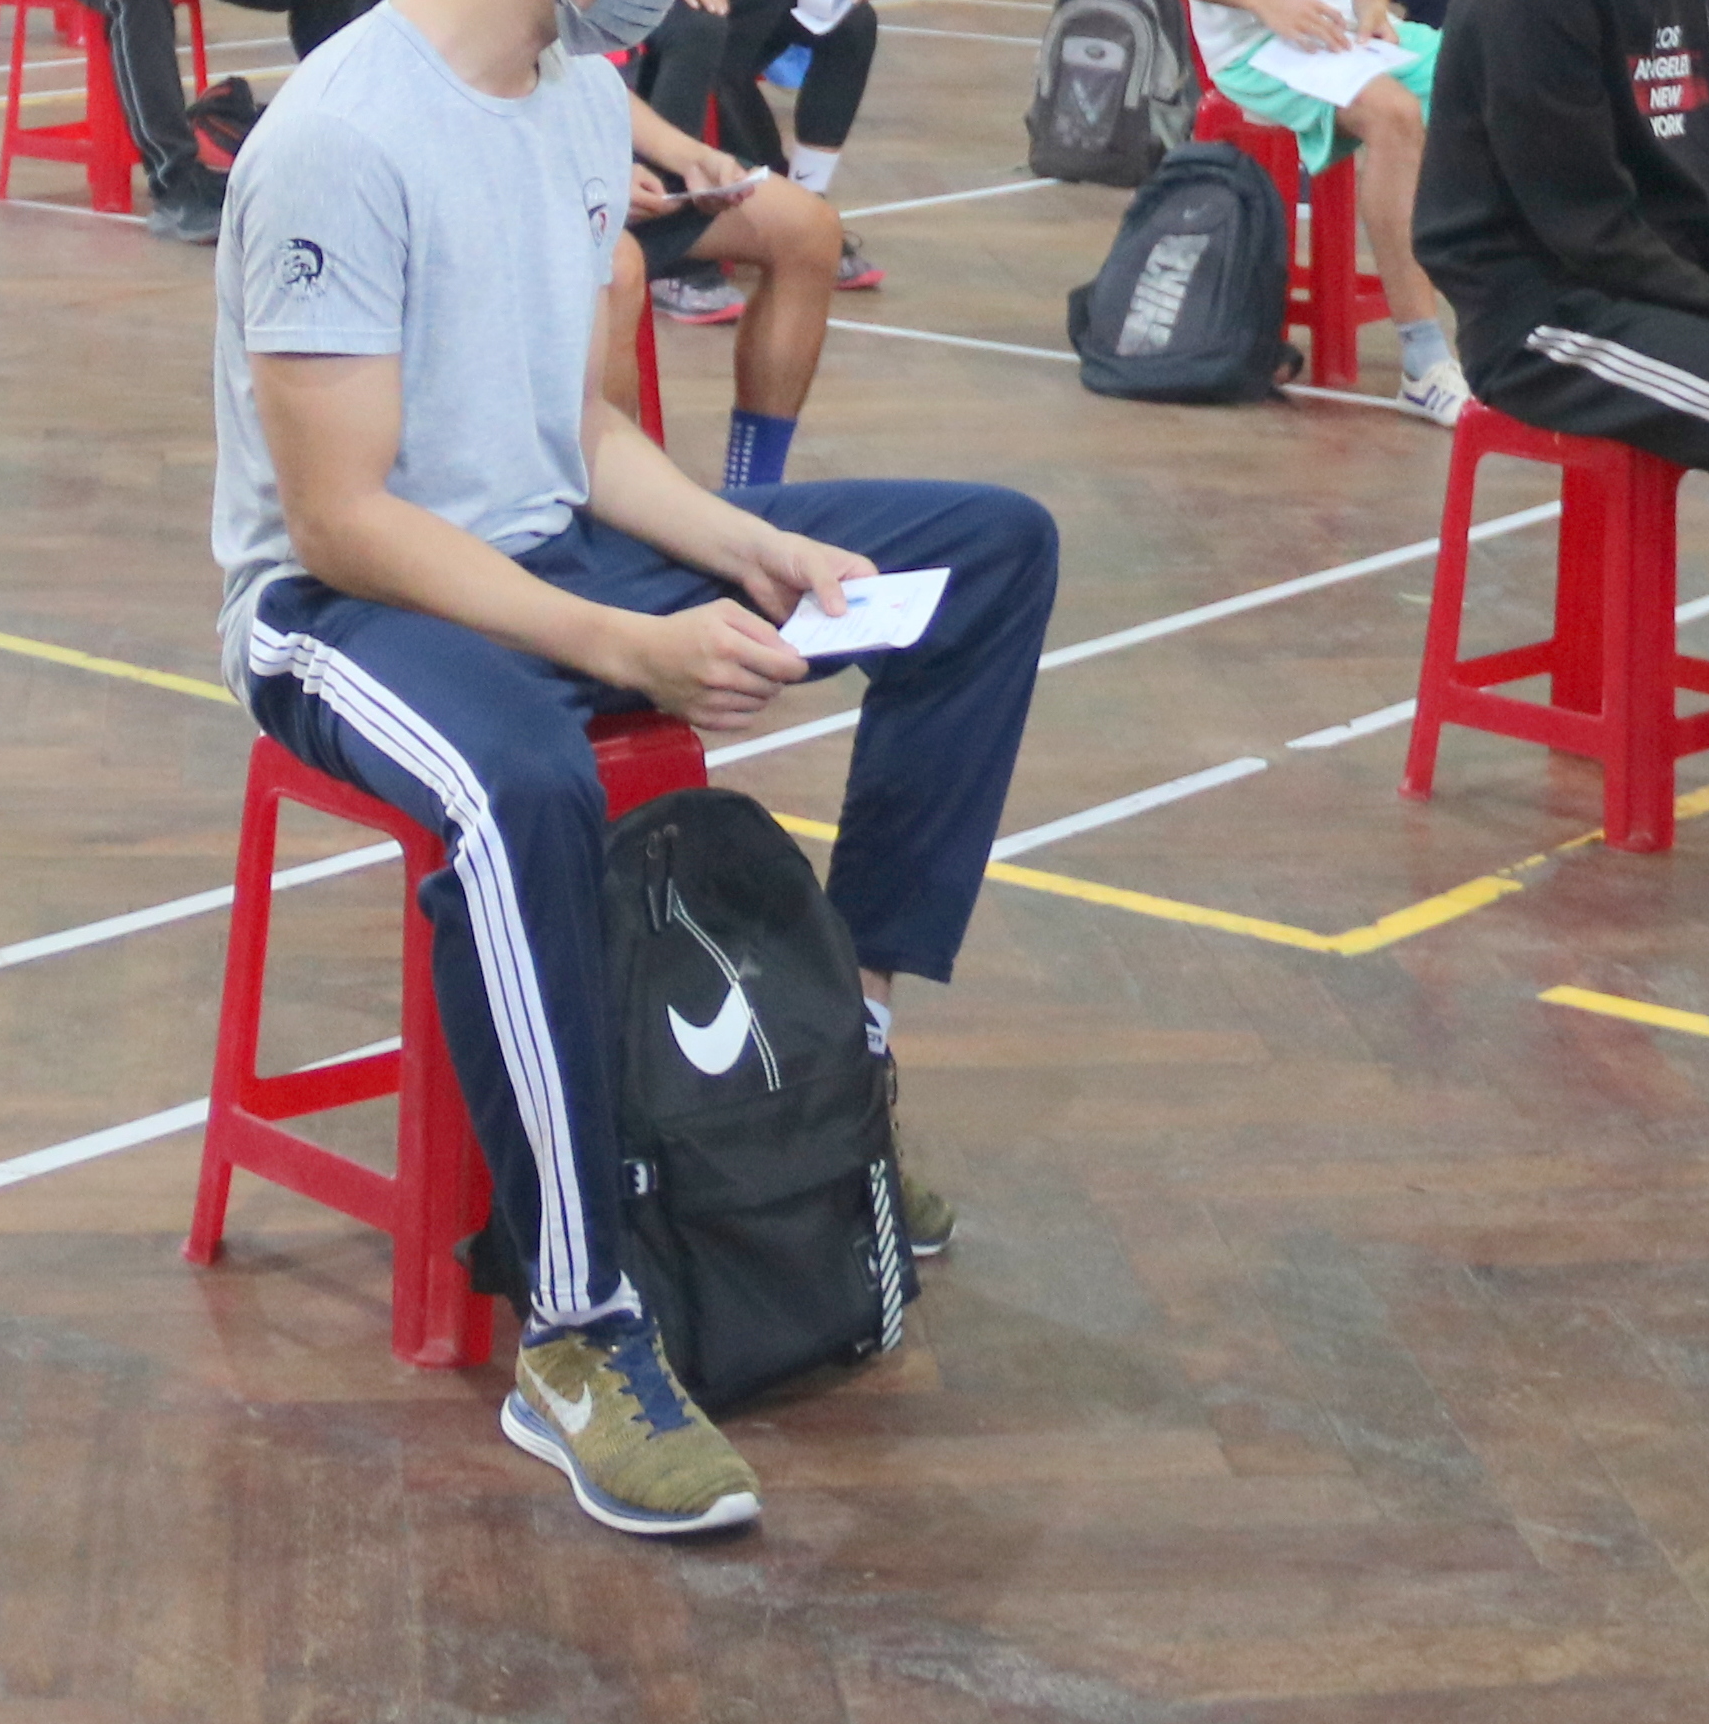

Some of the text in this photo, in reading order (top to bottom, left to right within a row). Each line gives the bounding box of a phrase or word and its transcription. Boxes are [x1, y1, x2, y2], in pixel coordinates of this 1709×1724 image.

[1633, 54, 1692, 81] ANGELE
[1650, 85, 1684, 110] NEW
[1649, 113, 1686, 139] YORK
